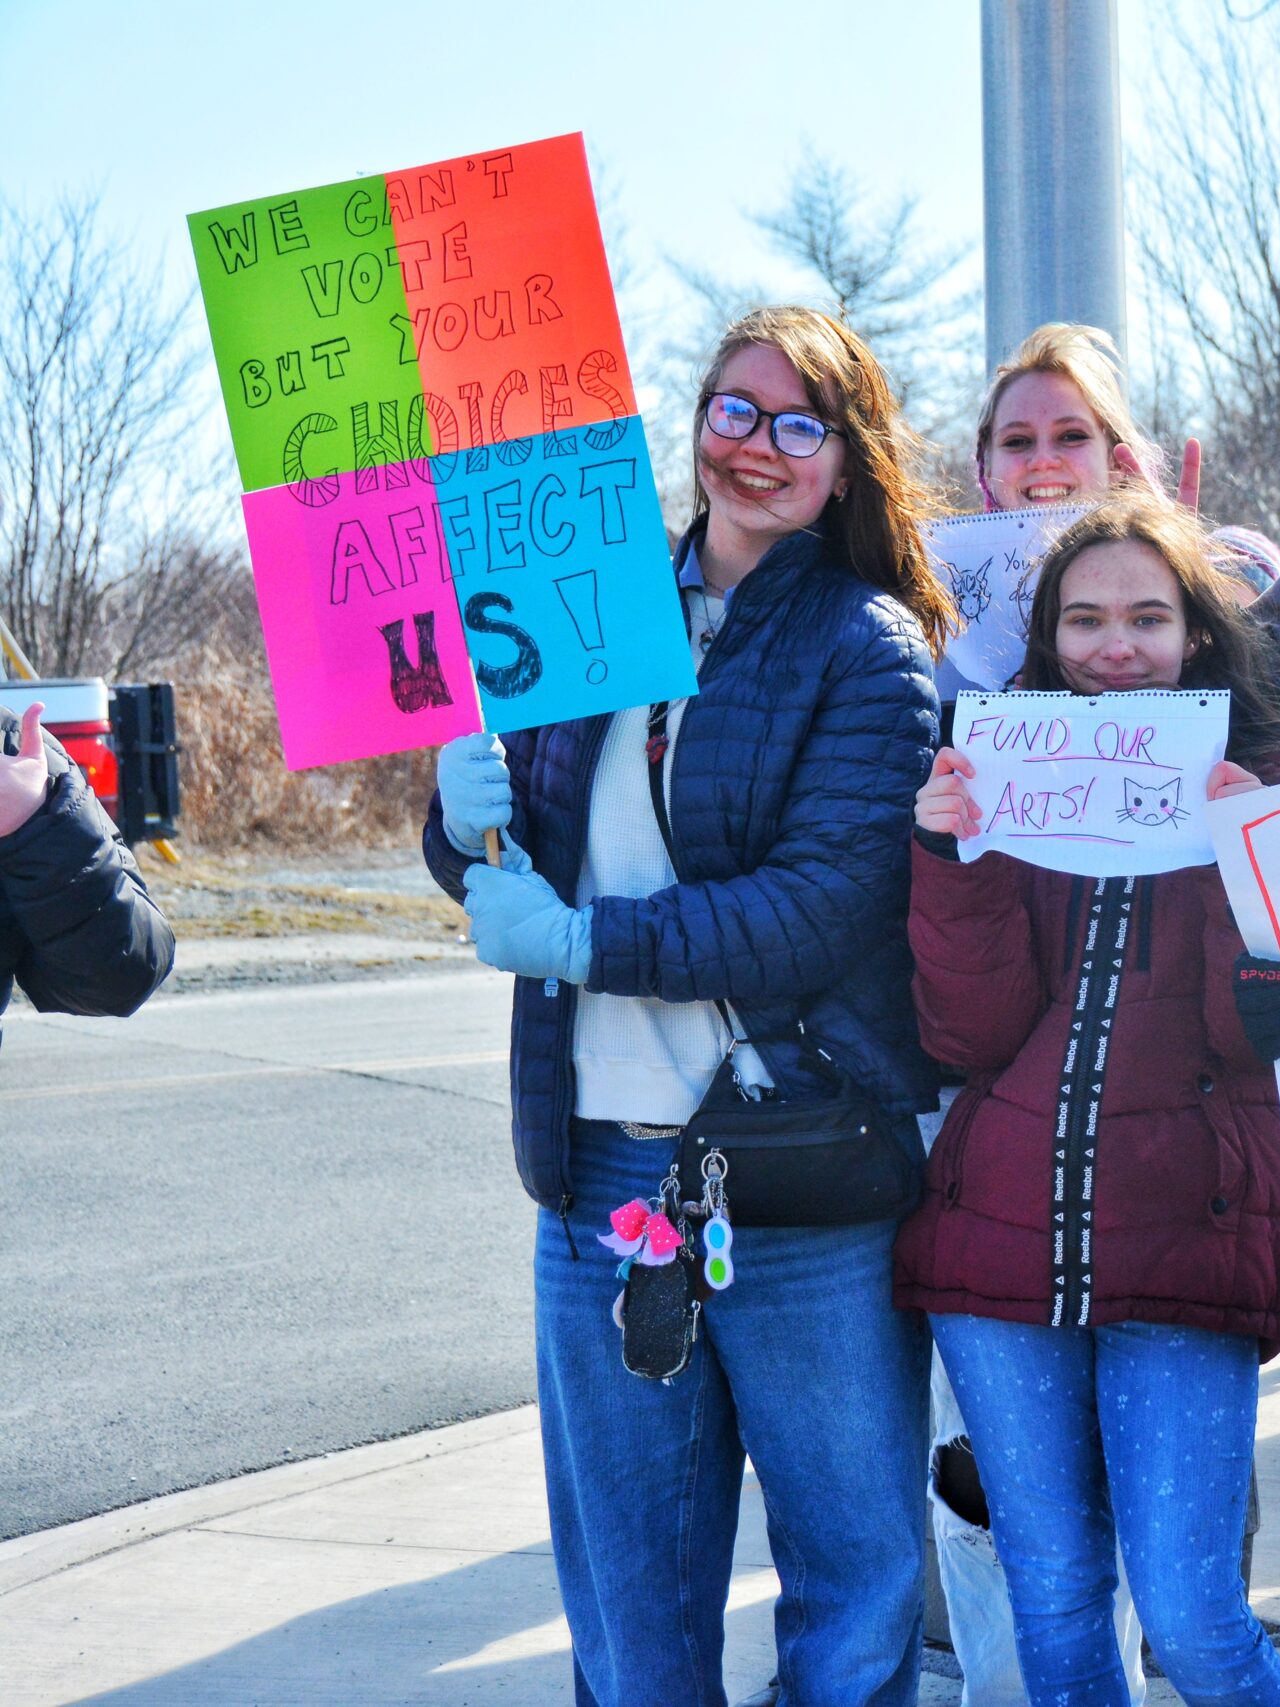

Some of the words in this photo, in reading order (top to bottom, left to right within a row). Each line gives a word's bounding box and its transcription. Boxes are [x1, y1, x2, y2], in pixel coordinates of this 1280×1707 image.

[208, 201, 310, 275] WE
[345, 152, 514, 238] CAN'T
[301, 221, 474, 318] VOTE
[239, 336, 352, 409] BUT
[389, 273, 563, 364] YOUR
[284, 349, 629, 508] CHOICES
[330, 457, 637, 605] AFFECT
[376, 568, 608, 714] US!
[966, 714, 1072, 756] FUND
[1094, 721, 1160, 765] OUR
[985, 775, 1099, 834] ARTS!
[1086, 918, 1099, 950] Reebok
[1115, 917, 1128, 949] Reebok
[1077, 976, 1089, 1010] Reebok
[1105, 974, 1119, 1008] Reebok
[1064, 1038, 1079, 1073] Reebok
[1094, 1035, 1108, 1072] Reebok
[1056, 1101, 1068, 1138] Reebok
[1086, 1100, 1099, 1136] Reebok
[1054, 1166, 1064, 1201] Reebok
[1082, 1165, 1093, 1200] Reebok
[1054, 1229, 1064, 1265] Reebok
[1080, 1228, 1091, 1264] Reebok
[1052, 1292, 1064, 1327] Reebok
[1078, 1291, 1090, 1326] Reebok
